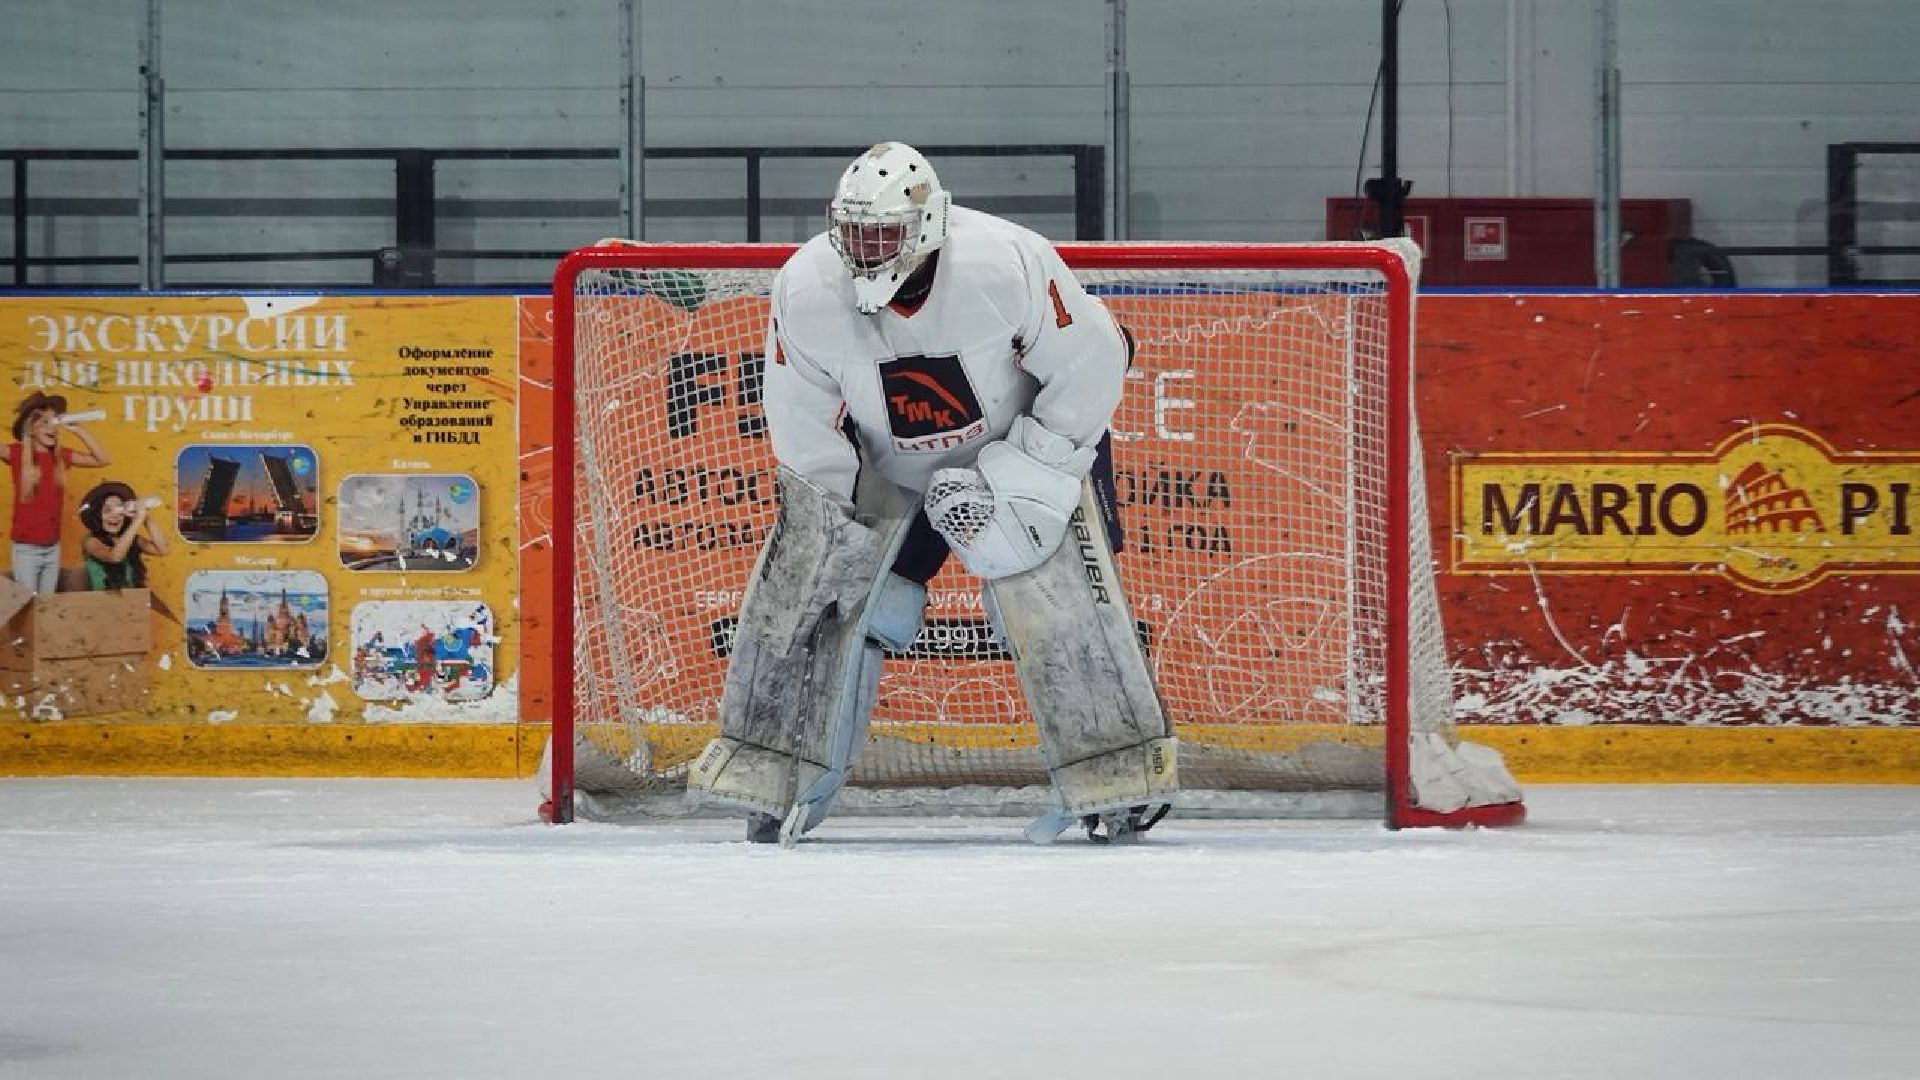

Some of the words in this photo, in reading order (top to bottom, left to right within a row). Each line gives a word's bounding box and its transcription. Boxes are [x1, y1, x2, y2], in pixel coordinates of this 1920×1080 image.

[1047, 279, 1073, 329] 1
[27, 314, 350, 353] ЭКСКУРСИИ
[398, 346, 494, 361] Оформление
[22, 359, 99, 390] для
[116, 359, 355, 386] школьных
[403, 365, 490, 379] документов
[403, 397, 490, 412] Управление
[426, 383, 467, 396] через
[122, 394, 253, 432] групп
[888, 394, 957, 429] ТМК
[413, 434, 422, 443] и
[426, 431, 481, 445] ГИБДД
[633, 467, 782, 506] АВТОС
[1114, 461, 1232, 508] ОЙКА
[1482, 482, 1708, 536] MARIO
